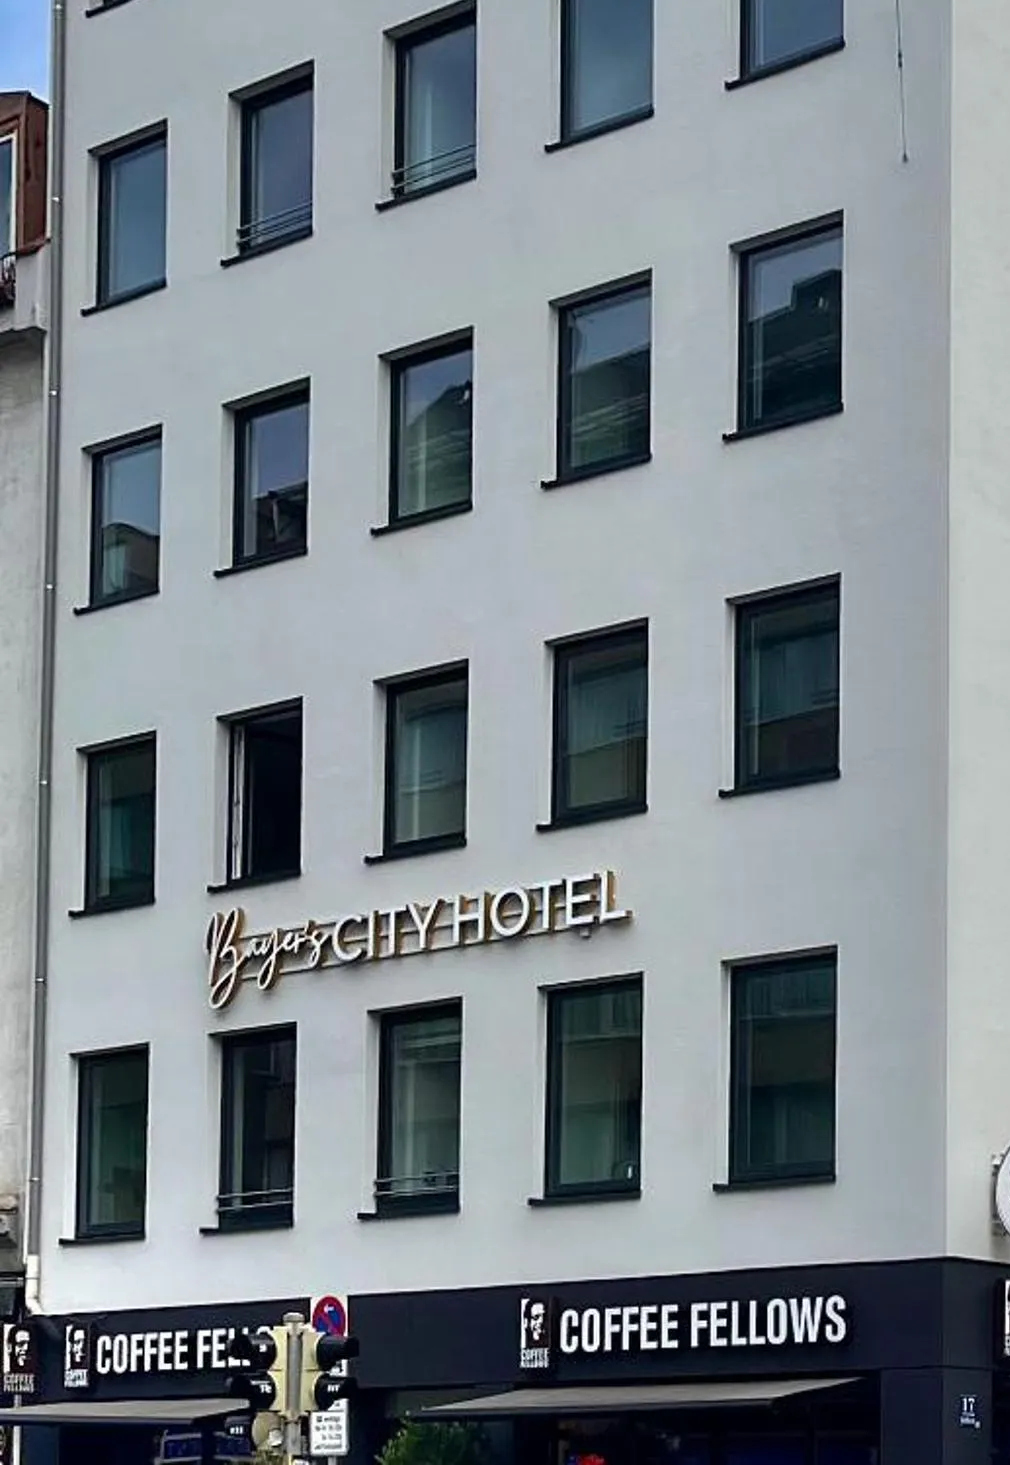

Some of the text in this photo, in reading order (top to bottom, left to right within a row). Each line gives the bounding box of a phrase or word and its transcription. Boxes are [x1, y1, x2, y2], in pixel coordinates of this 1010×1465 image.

[559, 1294, 848, 1354] COFFEE FELLOWS
[96, 1333, 188, 1375] COFFEE
[963, 1397, 975, 1412] 17
